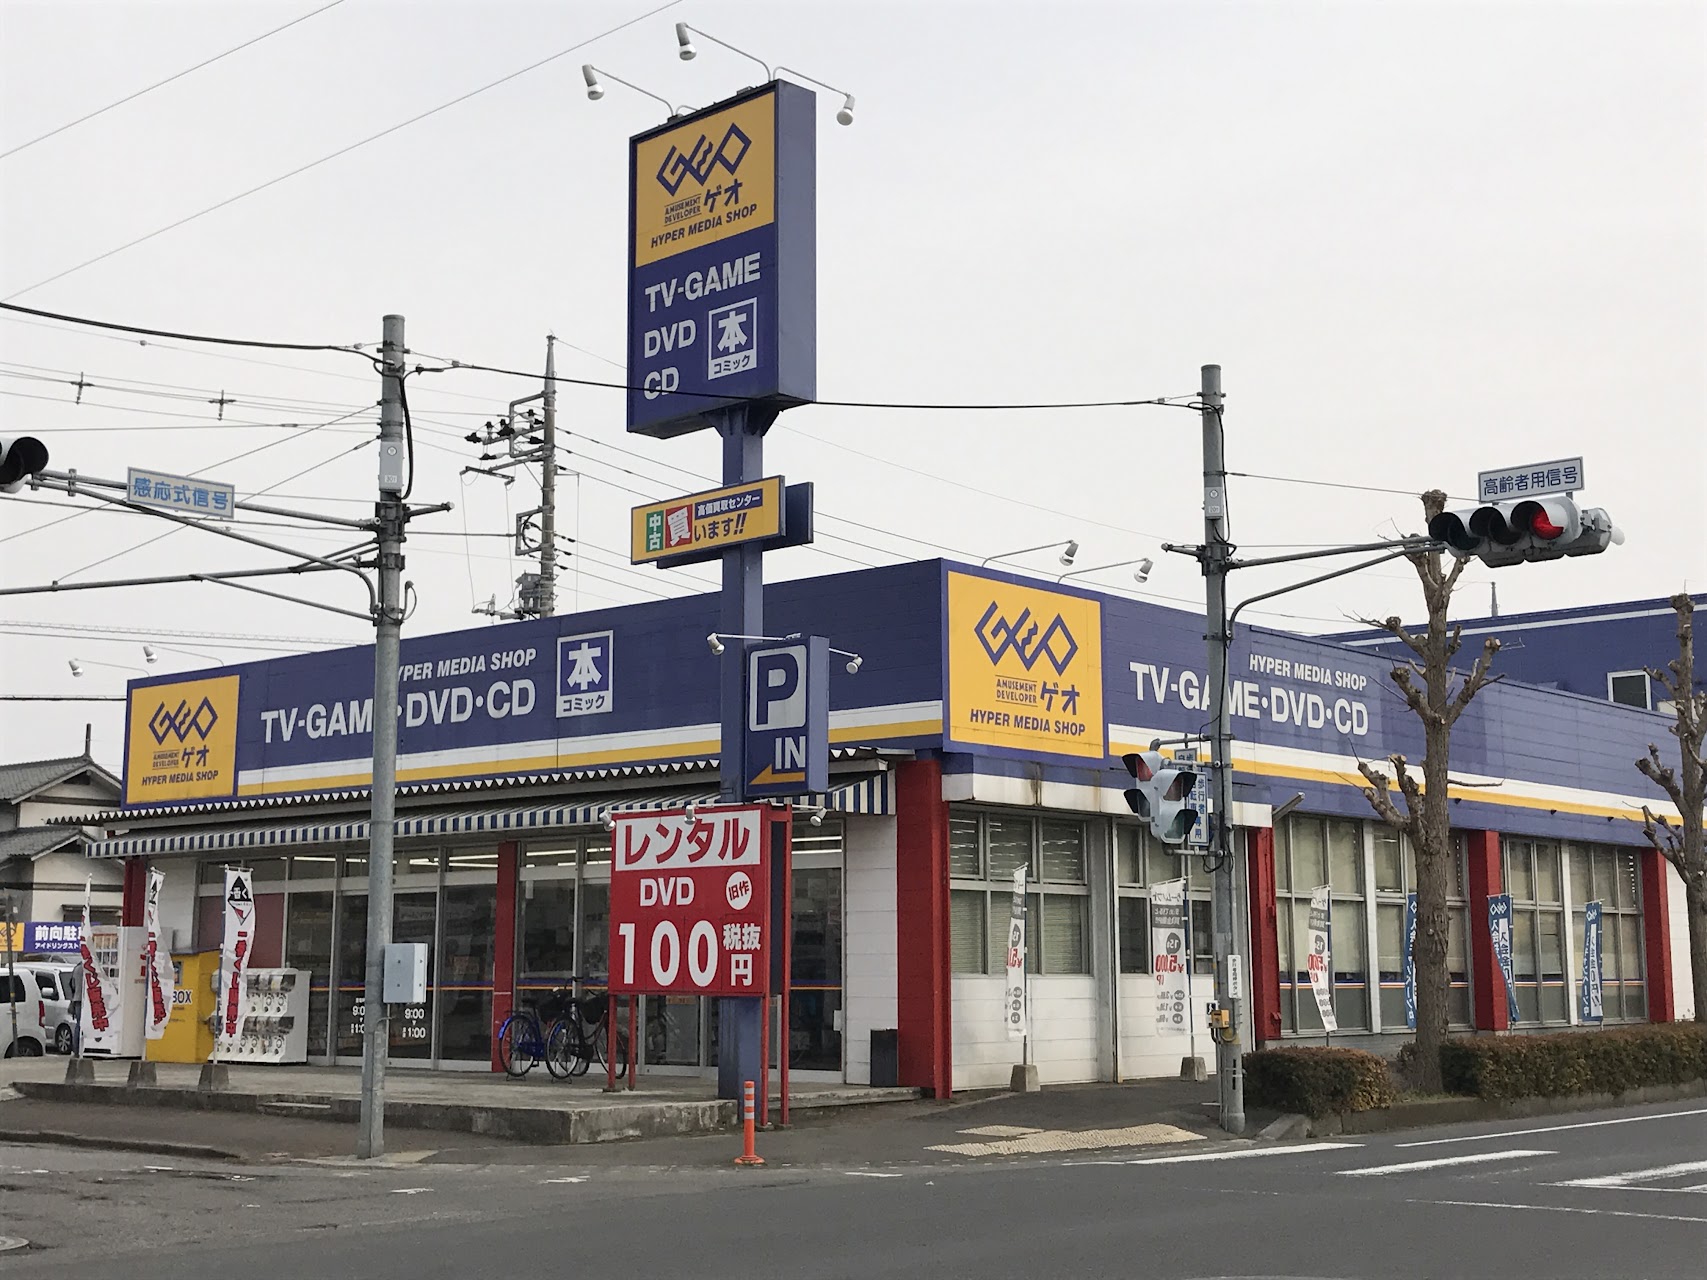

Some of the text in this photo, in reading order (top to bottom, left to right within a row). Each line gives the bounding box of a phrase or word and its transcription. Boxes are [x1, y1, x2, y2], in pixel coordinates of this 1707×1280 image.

[665, 196, 701, 215] AMUSEMENT
[704, 178, 743, 213] ゲオ
[651, 203, 757, 248] HYPER MEDIA SHOP
[665, 205, 701, 223] DEVELOPER
[644, 251, 761, 313] TV-GAME
[643, 319, 697, 358] DVD
[717, 311, 748, 353] 本
[714, 354, 751, 375] コミック
[643, 366, 680, 400] CD
[133, 477, 228, 511] 感応式信号
[1483, 466, 1578, 496] 高齢者用信号
[649, 514, 661, 551] 中古
[397, 648, 536, 682] YPER MEDIA SHOP
[567, 642, 602, 691] 本
[1250, 653, 1367, 691] HYPER MEDIA SHOP
[756, 652, 799, 726] P
[996, 679, 1037, 693] AMUSEMENT
[996, 689, 1037, 703] DEVELOPER
[1039, 680, 1080, 715] ゲオ
[563, 695, 606, 713] コミック
[970, 708, 1086, 736] HYPER MEDIA SHOP
[181, 744, 209, 768] ゲオ
[775, 735, 806, 770] IN
[142, 769, 219, 786] HYPER MEDIA SHOP
[625, 817, 751, 866] レンタル
[640, 876, 695, 907] DVD
[728, 880, 750, 901] 旧作
[35, 925, 82, 941] 前向駐
[35, 942, 80, 950] アイドリングスト
[722, 923, 761, 950] 税抜
[618, 920, 719, 987] 100
[730, 953, 753, 986] 円
[352, 1006, 366, 1016] 9:0
[405, 1008, 425, 1019] 9:00
